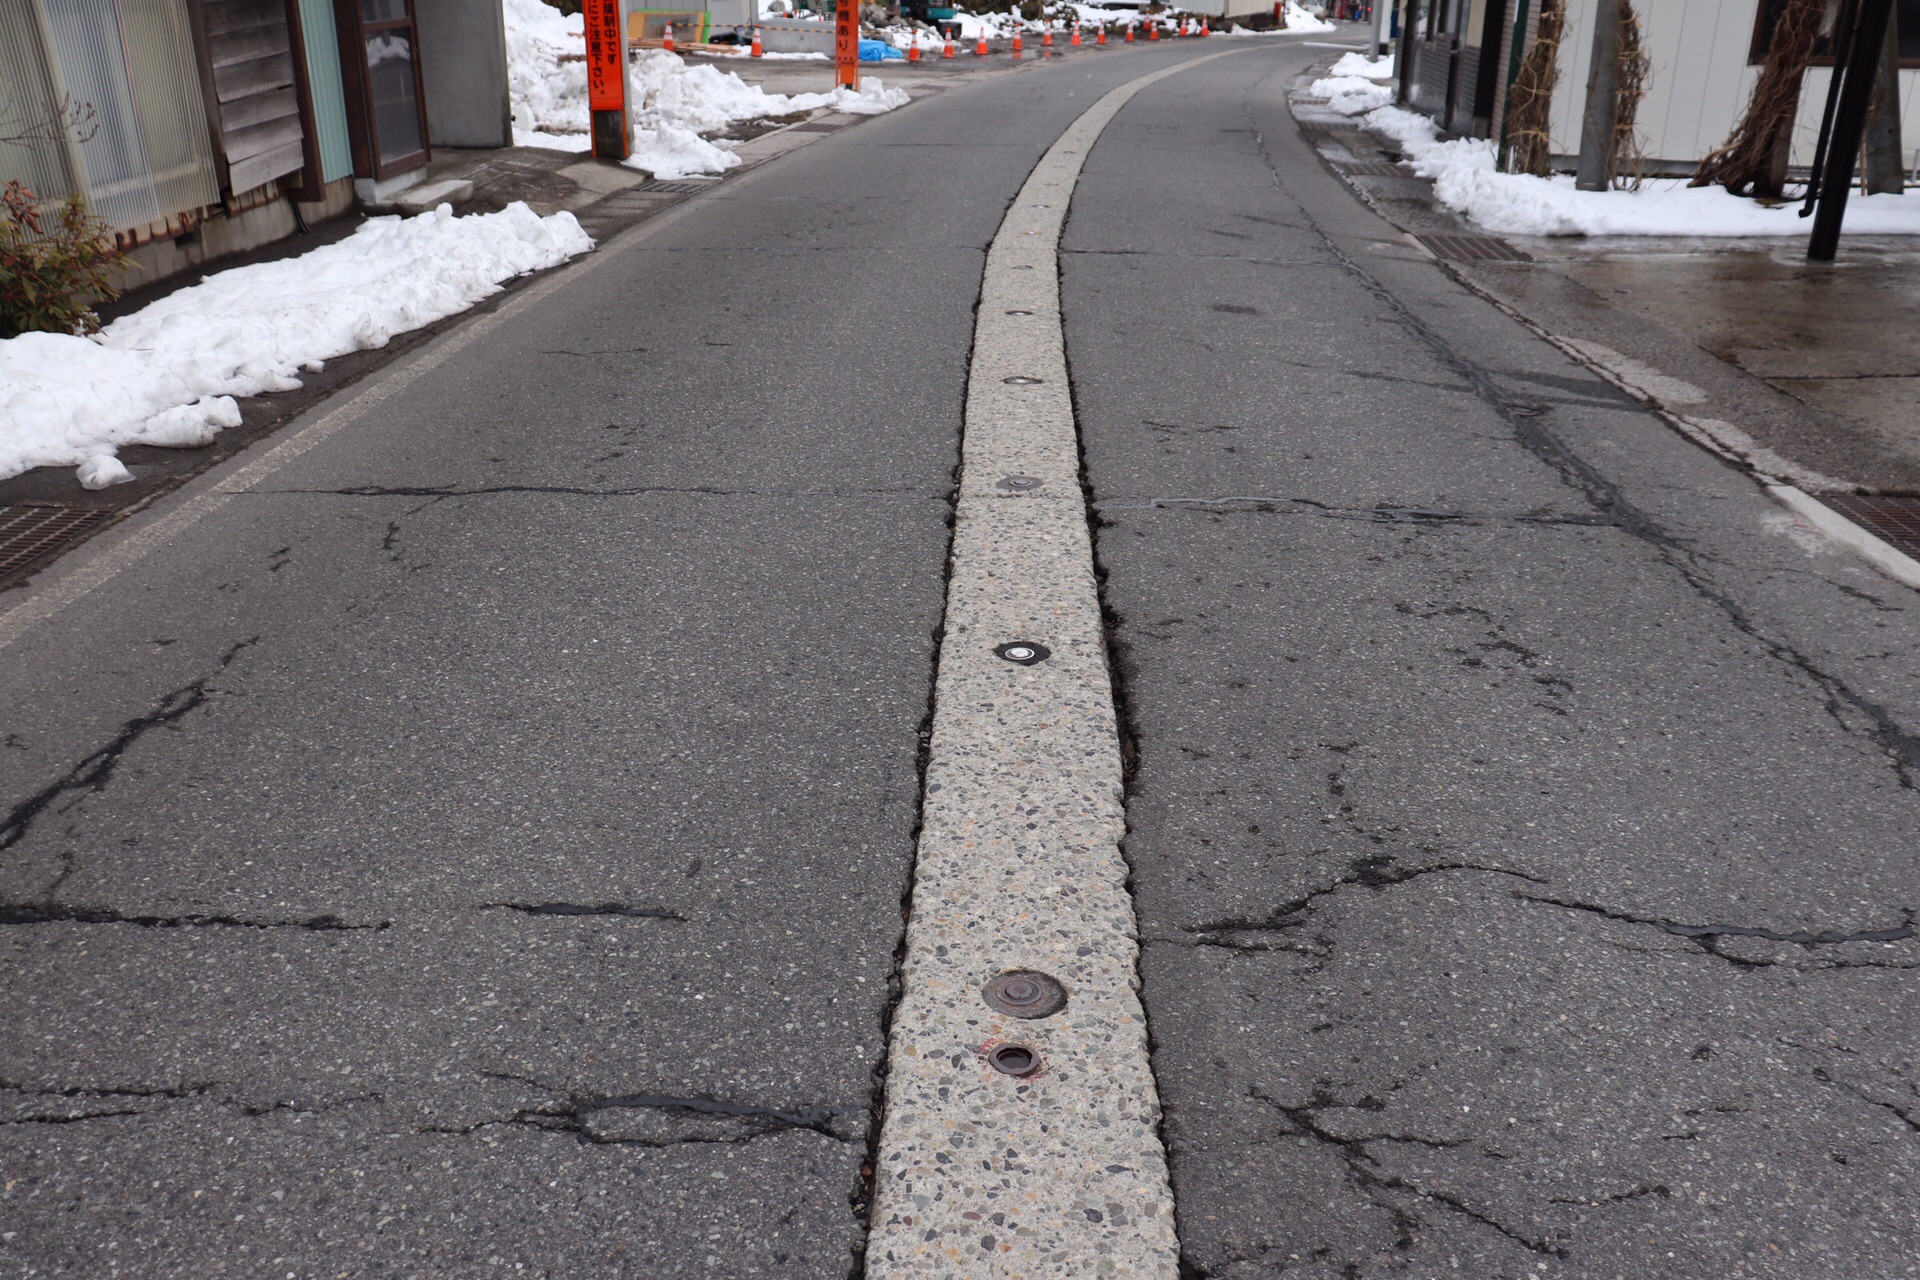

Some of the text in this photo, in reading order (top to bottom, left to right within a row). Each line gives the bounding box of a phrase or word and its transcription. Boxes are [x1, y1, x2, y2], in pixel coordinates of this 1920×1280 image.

[588, 0, 605, 95] にご注意下さい。
[603, 0, 617, 64] 規制中です
